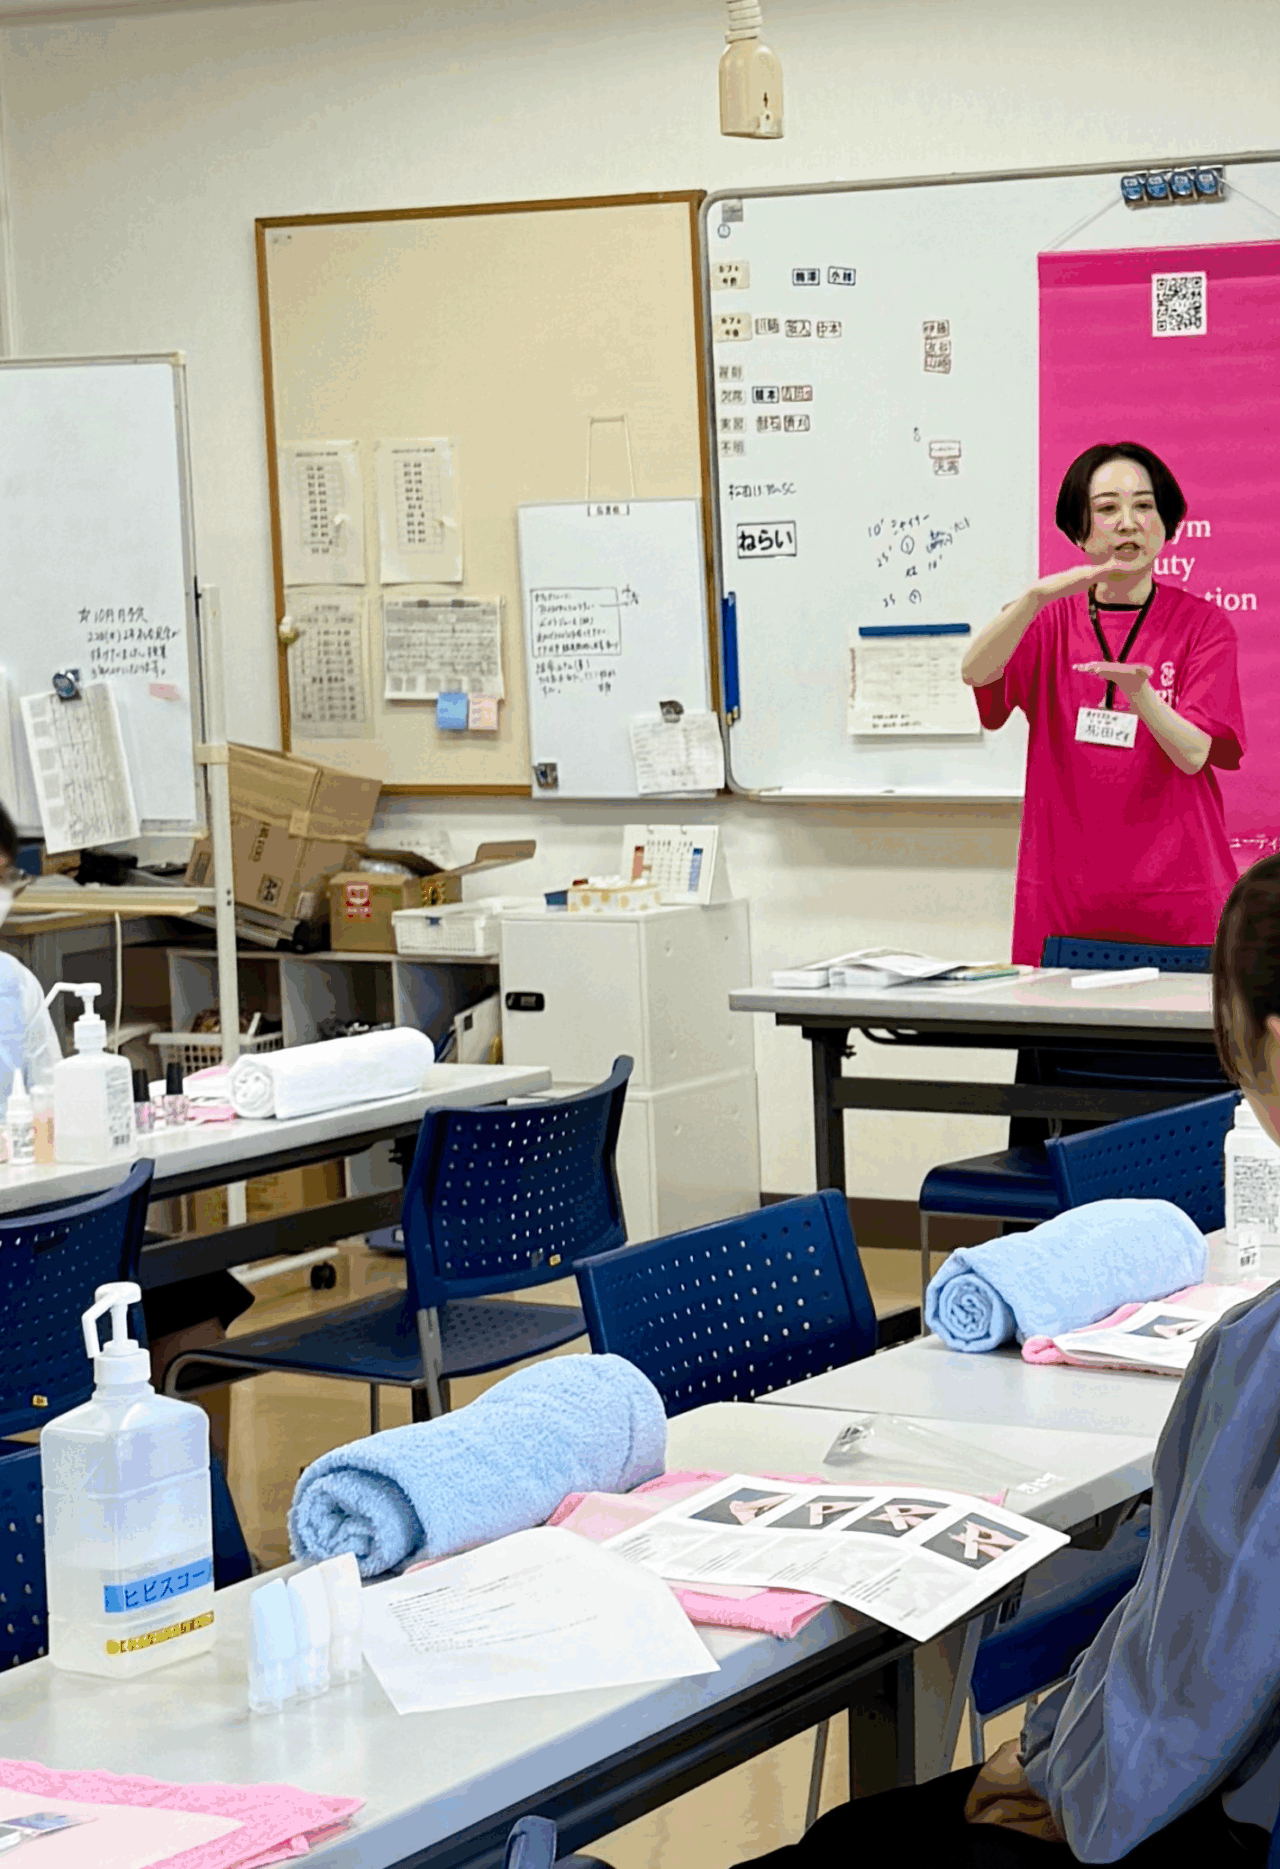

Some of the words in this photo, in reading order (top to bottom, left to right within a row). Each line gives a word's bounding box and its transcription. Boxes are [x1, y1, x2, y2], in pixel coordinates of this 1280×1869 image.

[738, 529, 793, 552] ねらい
[1171, 520, 1211, 545] ym
[1154, 555, 1195, 582] uty
[1204, 587, 1257, 611] tion
